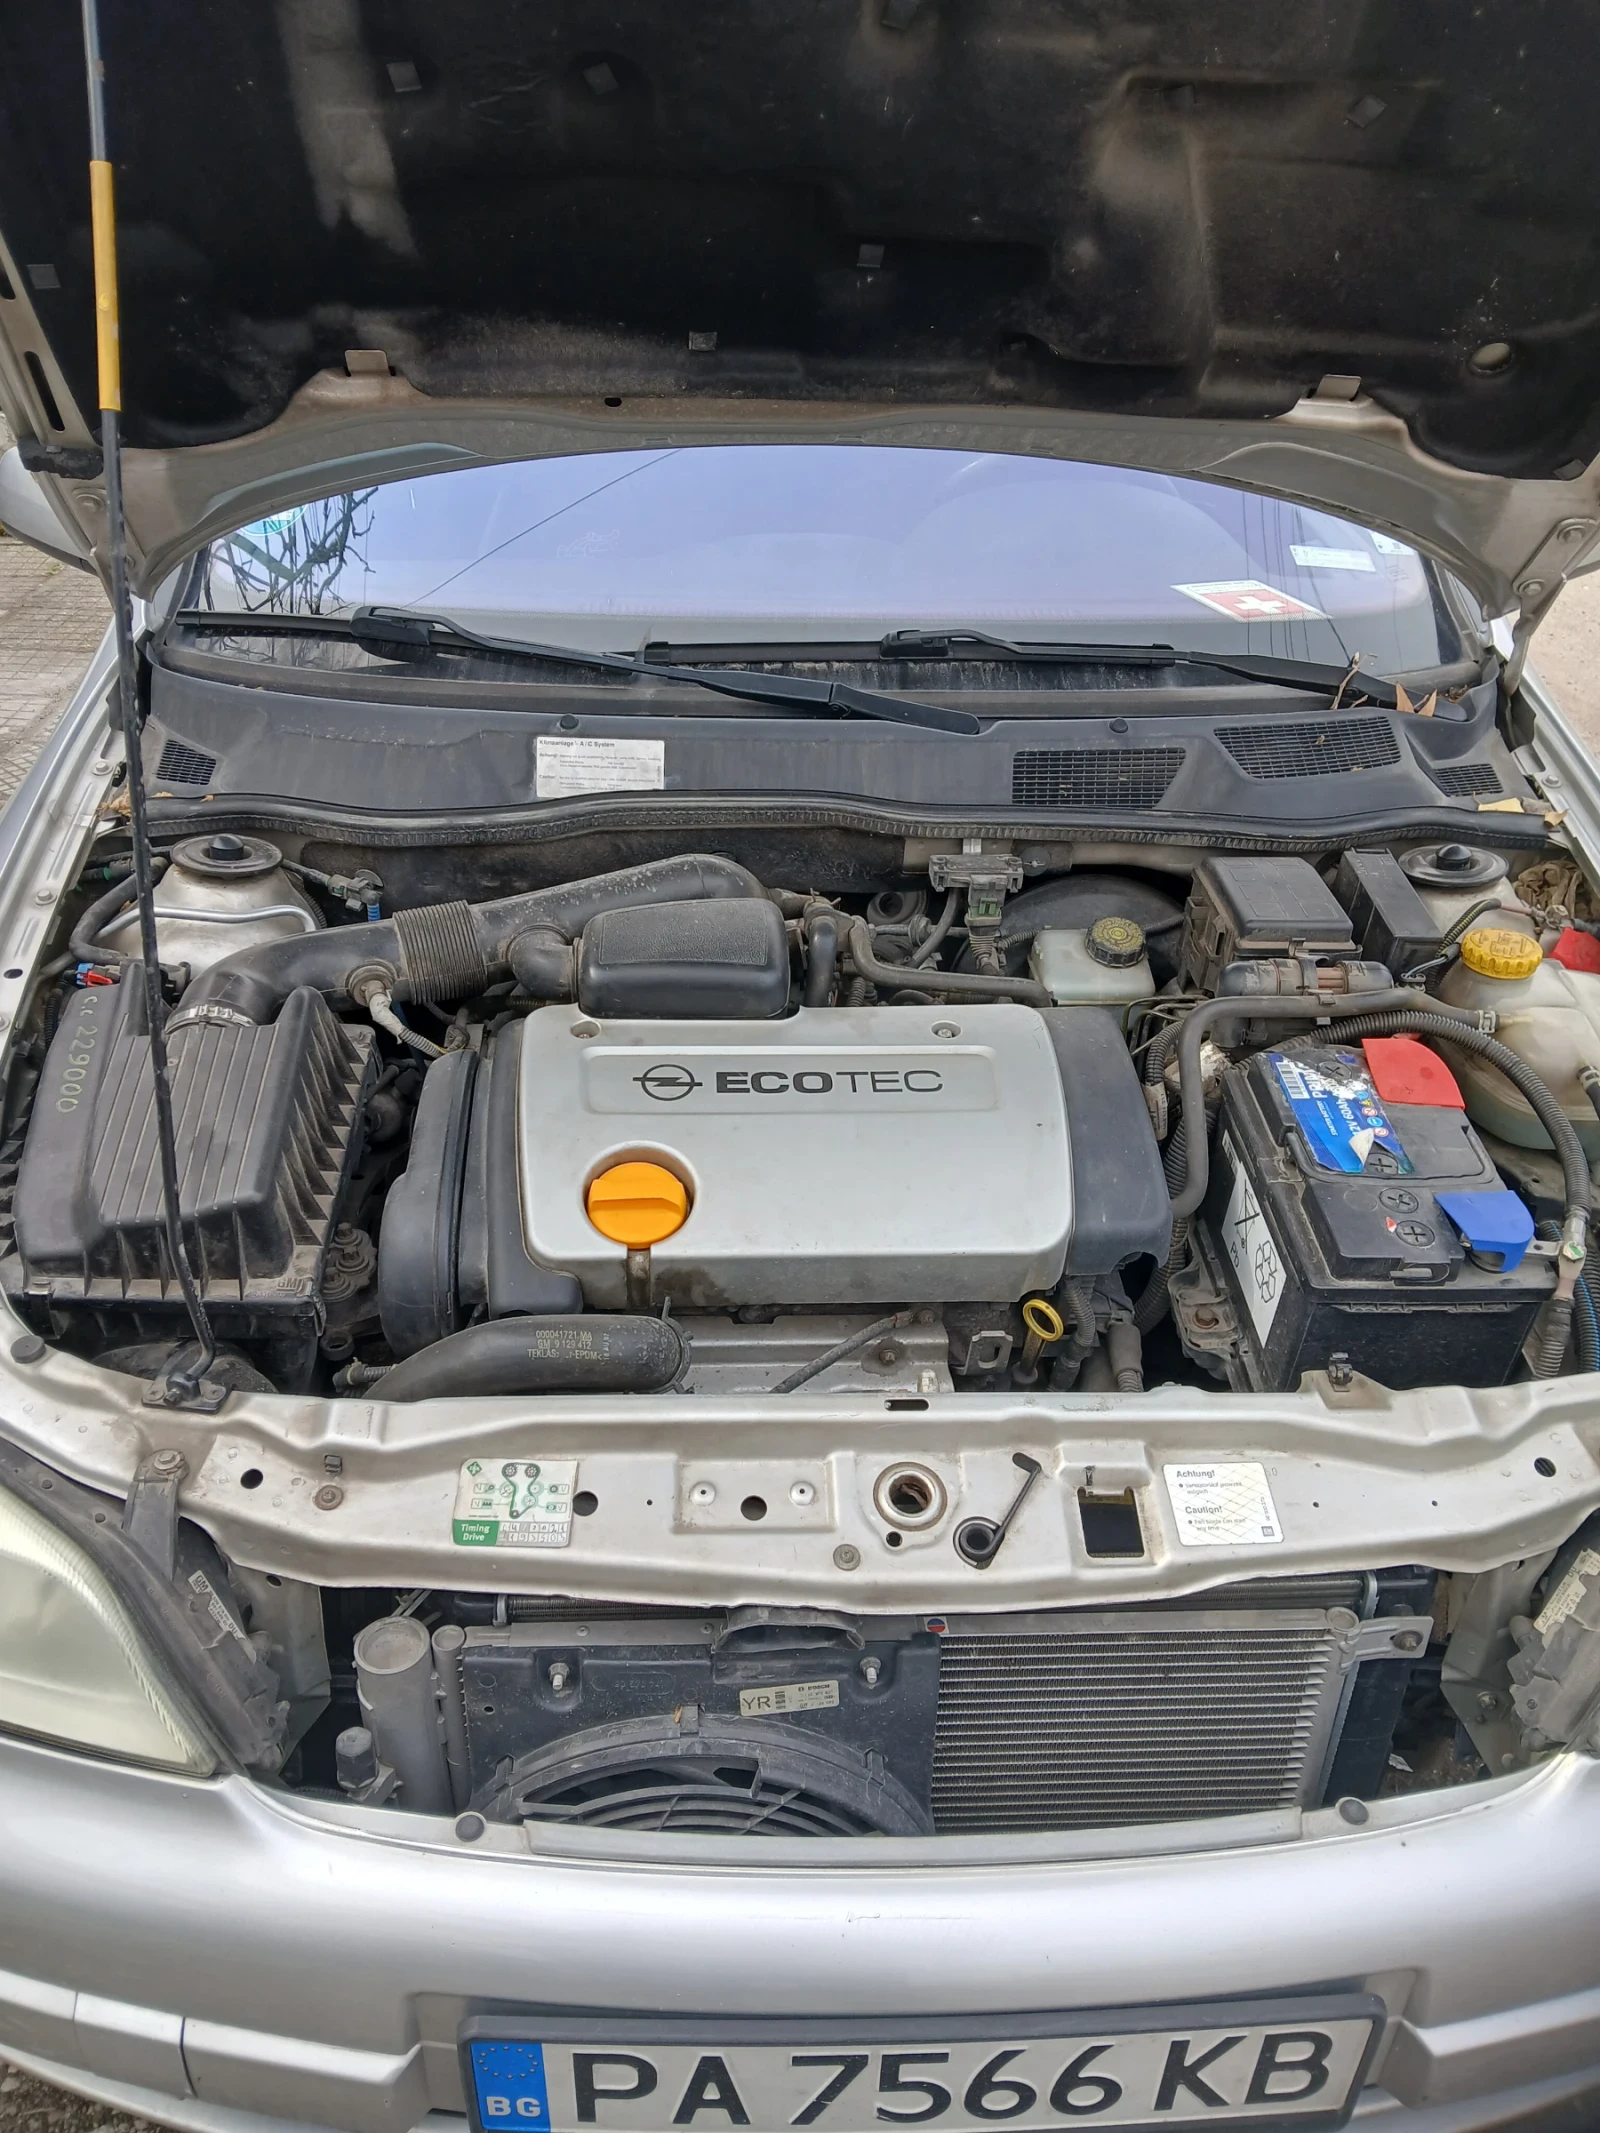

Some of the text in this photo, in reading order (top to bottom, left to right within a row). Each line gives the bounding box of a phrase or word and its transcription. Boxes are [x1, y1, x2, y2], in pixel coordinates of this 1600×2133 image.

[56, 1025, 98, 1113] 229000
[715, 1069, 944, 1094] ECOTEC
[537, 1339, 551, 1349] GM
[1176, 1470, 1216, 1479] Achtung!
[1185, 1506, 1223, 1514] Caution!
[461, 1524, 491, 1534] Timing
[463, 1532, 485, 1541] Drive
[196, 1574, 209, 1592] GM
[742, 1695, 771, 1710] YR
[572, 2030, 1334, 2126] PA 7566 KB
[486, 2096, 541, 2118] BG
